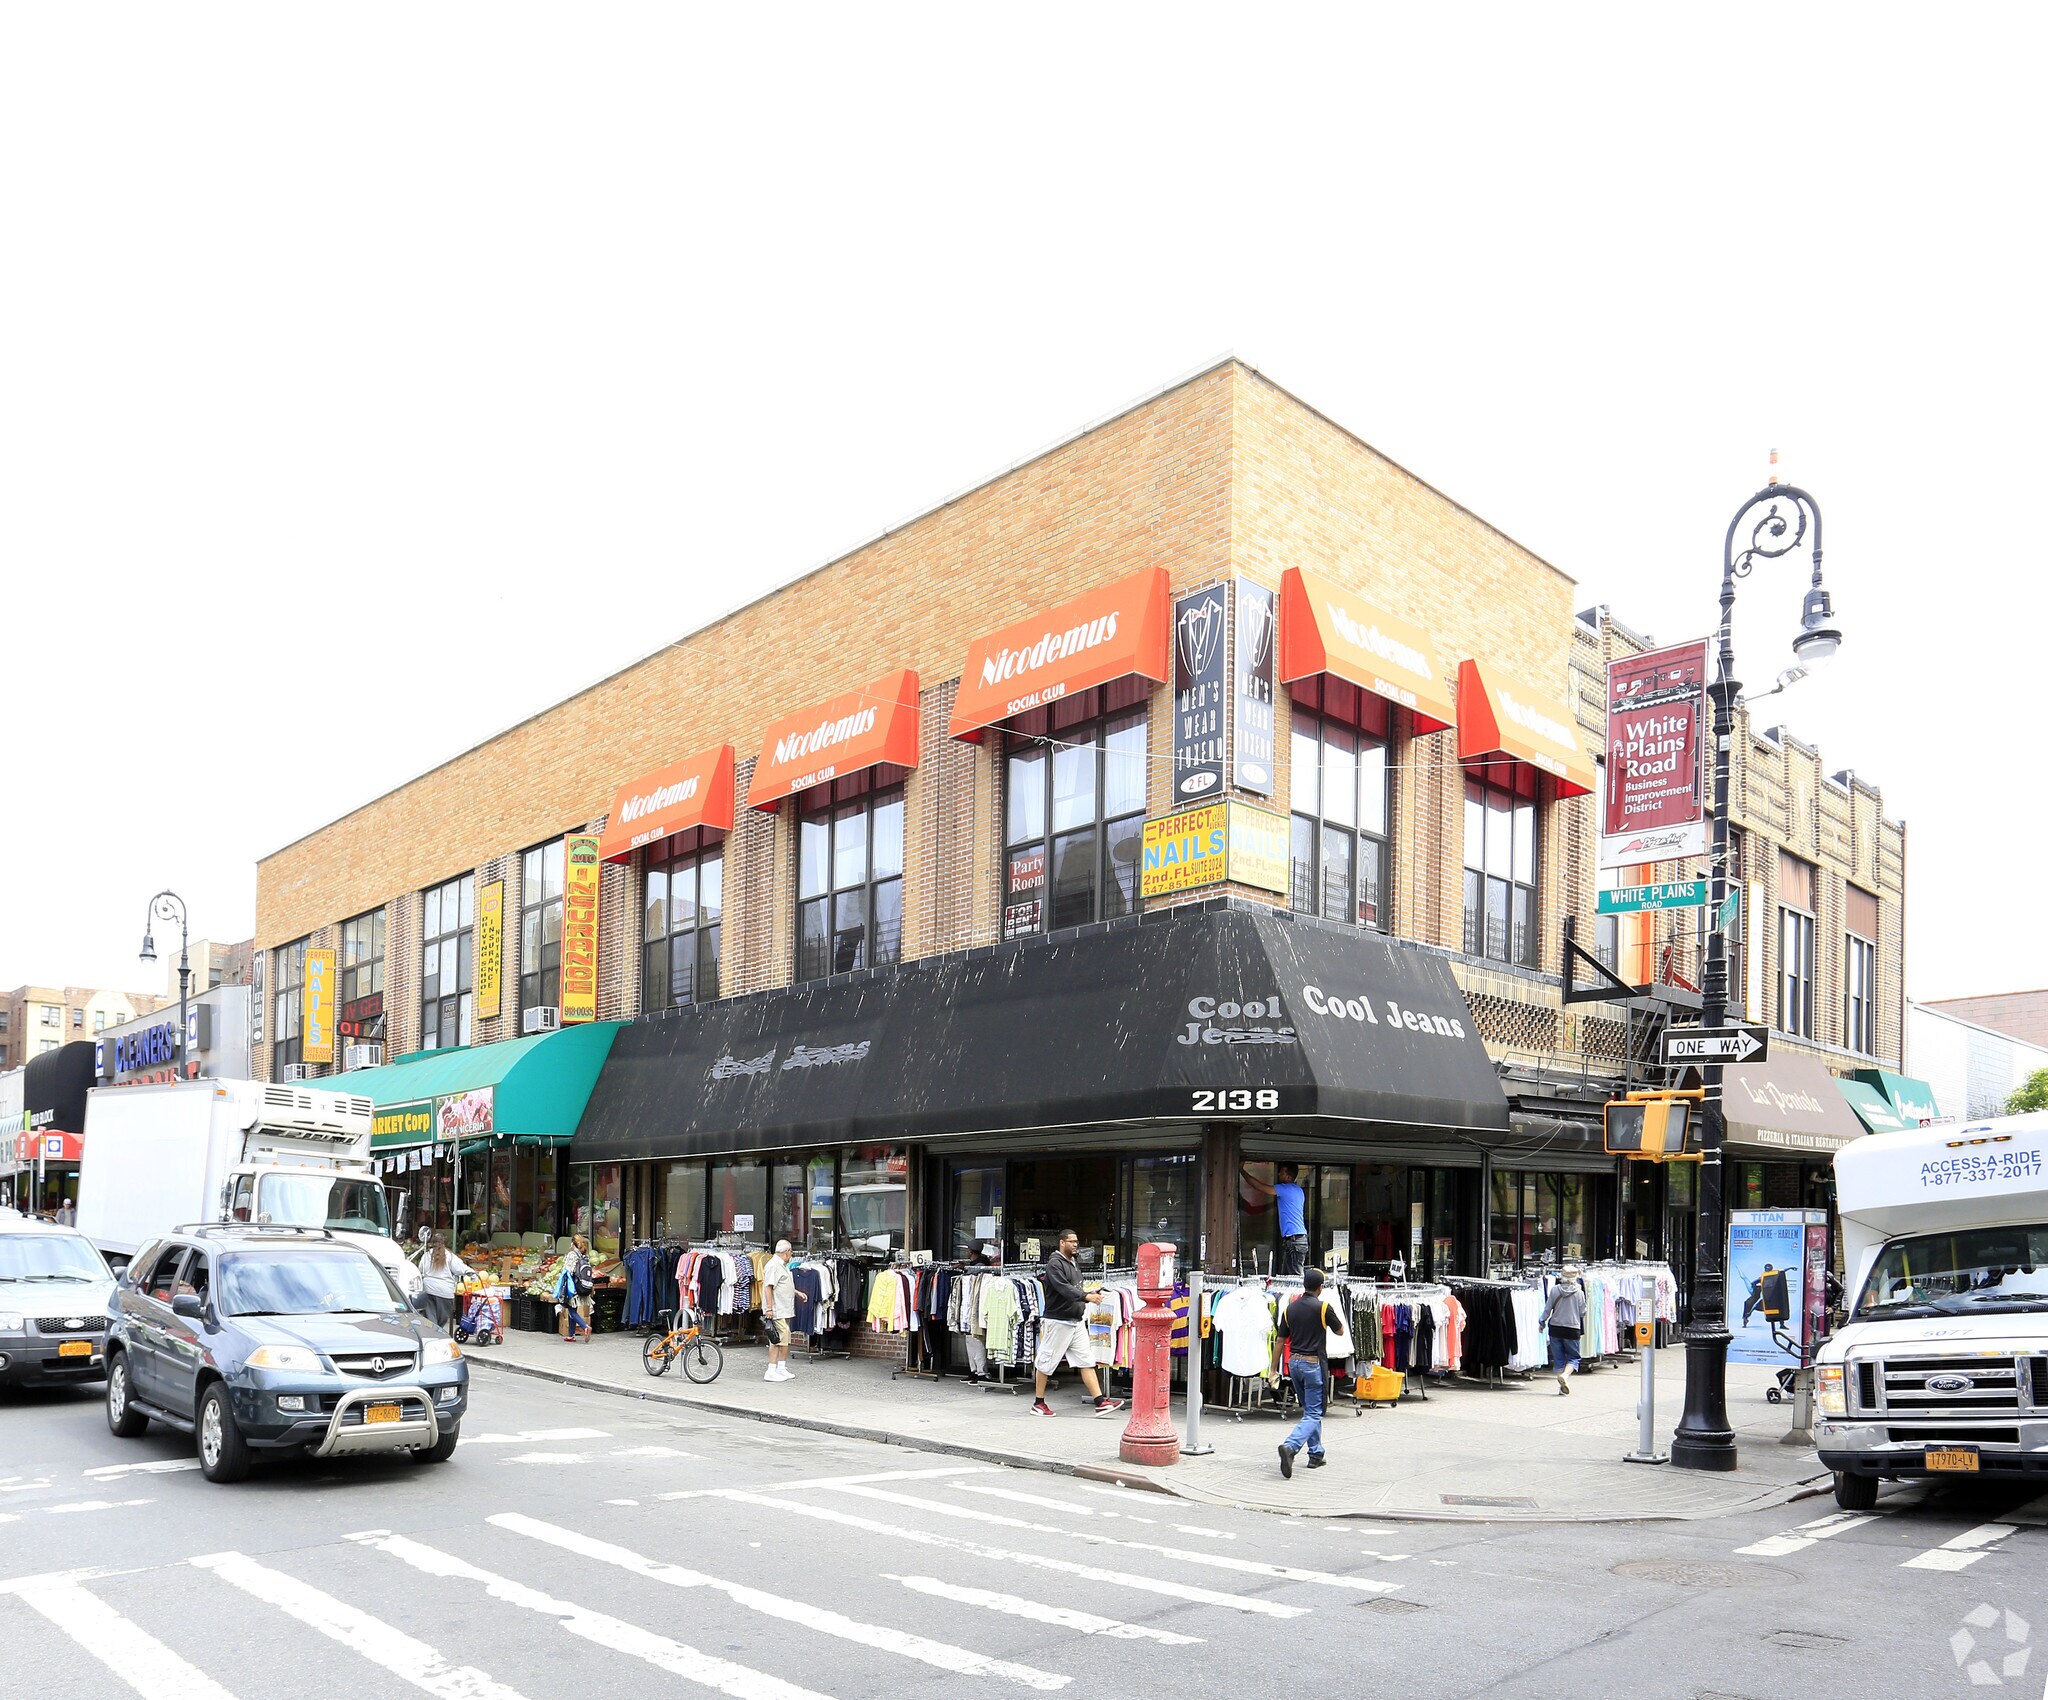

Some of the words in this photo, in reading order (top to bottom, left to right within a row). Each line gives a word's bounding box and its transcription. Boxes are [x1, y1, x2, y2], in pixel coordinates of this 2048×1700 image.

[978, 611, 1119, 689] Nicodemus
[1007, 693, 1040, 715] SOCIAL
[1041, 682, 1066, 701] CLUB
[1181, 681, 1219, 713] MEN'S
[1241, 671, 1269, 704] MEN'S
[1184, 709, 1216, 740] WEAR
[1244, 700, 1268, 731] WEAR
[1626, 715, 1688, 740] White
[770, 705, 878, 767] Nicodemus
[1626, 735, 1685, 759] Plains
[1177, 737, 1223, 771] TUXEDO
[1626, 752, 1677, 779] Road
[791, 774, 816, 791] SOCIAL
[817, 765, 835, 780] CLUB
[1625, 777, 1668, 793] Business
[617, 775, 700, 826] Nicodemus
[1625, 782, 1693, 805] Improvement
[1624, 800, 1664, 816] District
[1158, 809, 1212, 839] PERFECT
[1245, 809, 1281, 833] PERFECT
[631, 835, 650, 847] SOCIAL
[650, 826, 664, 839] CLUB
[1231, 823, 1288, 862] NAILS
[571, 853, 597, 863] AUTO
[1144, 829, 1225, 872] NAILS
[1012, 857, 1044, 876] Party
[1191, 861, 1208, 875] SUITE
[1208, 857, 1223, 872] 202A
[1010, 874, 1044, 893] Room
[1143, 871, 1223, 896] 347-851-5485
[1610, 888, 1646, 904] WHITE
[1651, 883, 1695, 900] PLAINS
[1011, 905, 1033, 918] FOR
[1641, 900, 1663, 910] ROAD
[565, 868, 596, 994] INSURANCE
[1007, 914, 1038, 930] RENT
[306, 951, 334, 959] PERFECT
[309, 960, 323, 1044] NAILS
[1188, 996, 1283, 1019] Cool
[1303, 985, 1379, 1025] Cool
[1386, 1001, 1466, 1039] Jeans
[115, 1021, 173, 1072] CLEANERS
[1676, 1040, 1705, 1054] ONE
[1720, 1039, 1752, 1053] WAY
[1192, 1089, 1280, 1111] 2138
[372, 1114, 404, 1136] ARKET
[405, 1113, 431, 1132] Corp
[1757, 1129, 1785, 1144] PIZZERIA
[1785, 1133, 1791, 1145] &
[1791, 1133, 1814, 1147] ITALIAN
[1921, 1150, 2042, 1175] ACCESS-A-RIDE
[1920, 1163, 2042, 1187] 1-877-337-2017
[1751, 1213, 1784, 1222] TITAN
[1734, 1229, 1750, 1239] DANCE
[1752, 1229, 1773, 1239] THEATRE
[1778, 1229, 1799, 1239] HARLEM
[916, 1253, 924, 1265] 6
[1922, 1329, 1975, 1338] 5077
[1936, 1378, 1959, 1390] Ford
